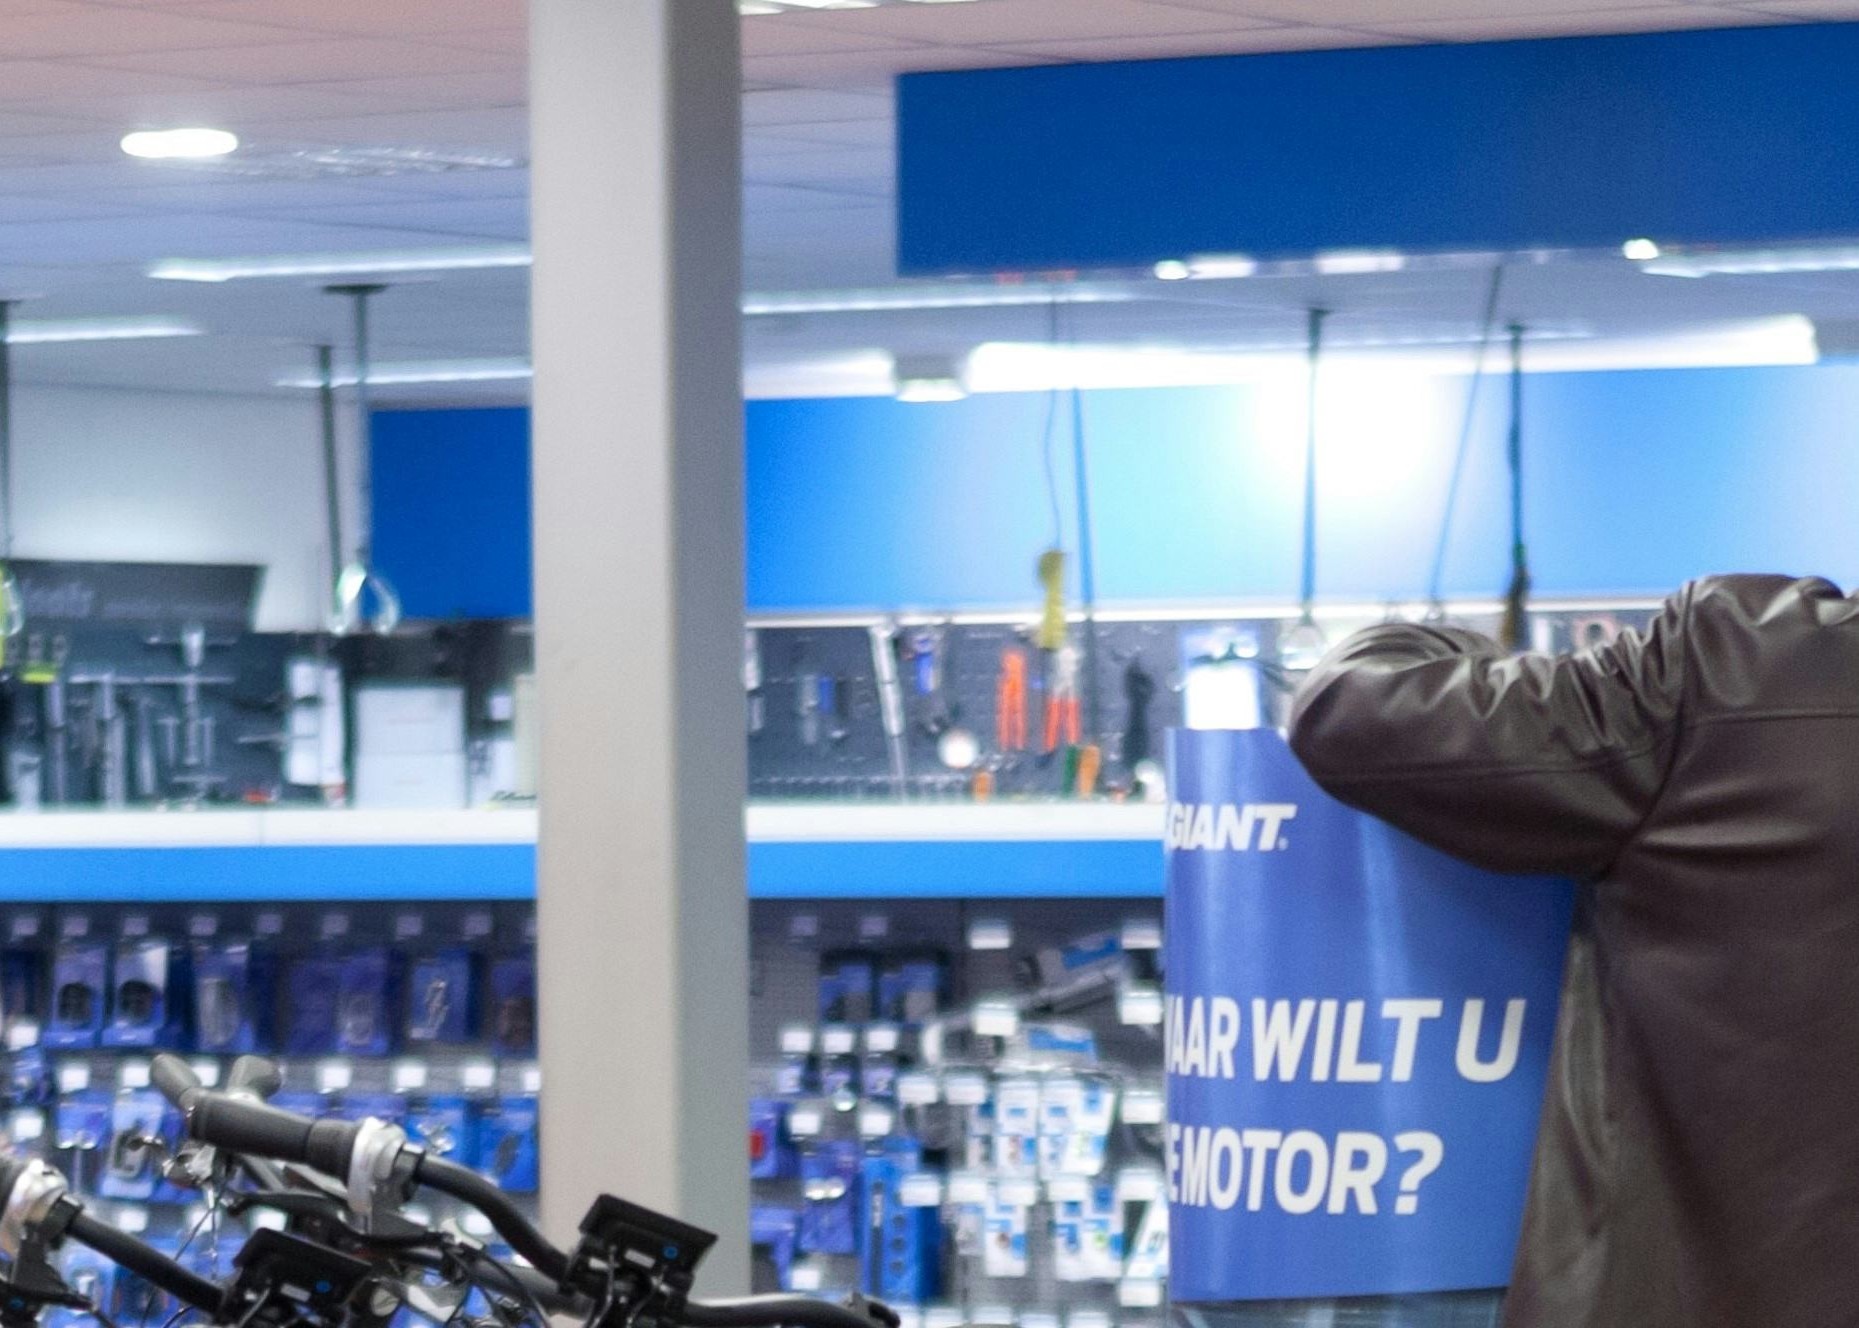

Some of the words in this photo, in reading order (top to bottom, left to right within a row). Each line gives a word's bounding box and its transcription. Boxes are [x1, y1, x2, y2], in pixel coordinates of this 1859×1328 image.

[1166, 803, 1296, 852] GIANT
[1165, 994, 1240, 1079] AAR
[1252, 999, 1442, 1082] WILT
[1455, 999, 1527, 1082] U
[1181, 1127, 1443, 1215] MOTOR?
